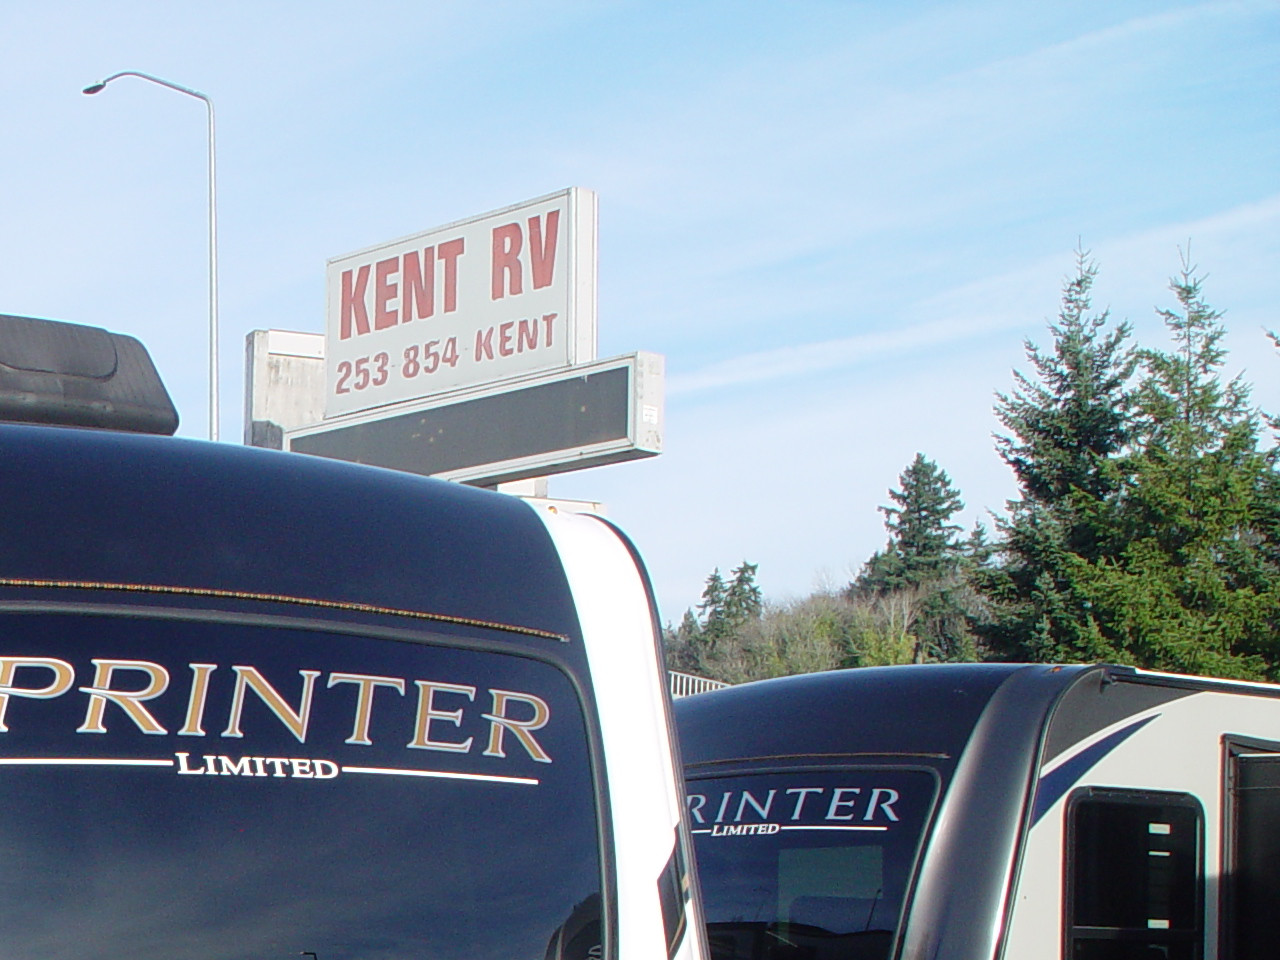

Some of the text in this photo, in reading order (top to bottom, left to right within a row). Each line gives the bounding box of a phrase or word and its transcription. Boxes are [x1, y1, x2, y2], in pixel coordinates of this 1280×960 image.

[339, 208, 561, 341] KENT RV
[335, 312, 558, 395] 253 854 KENT
[175, 752, 340, 780] LIMITED
[686, 787, 899, 824] RINTER
[710, 823, 780, 837] LIMITED
